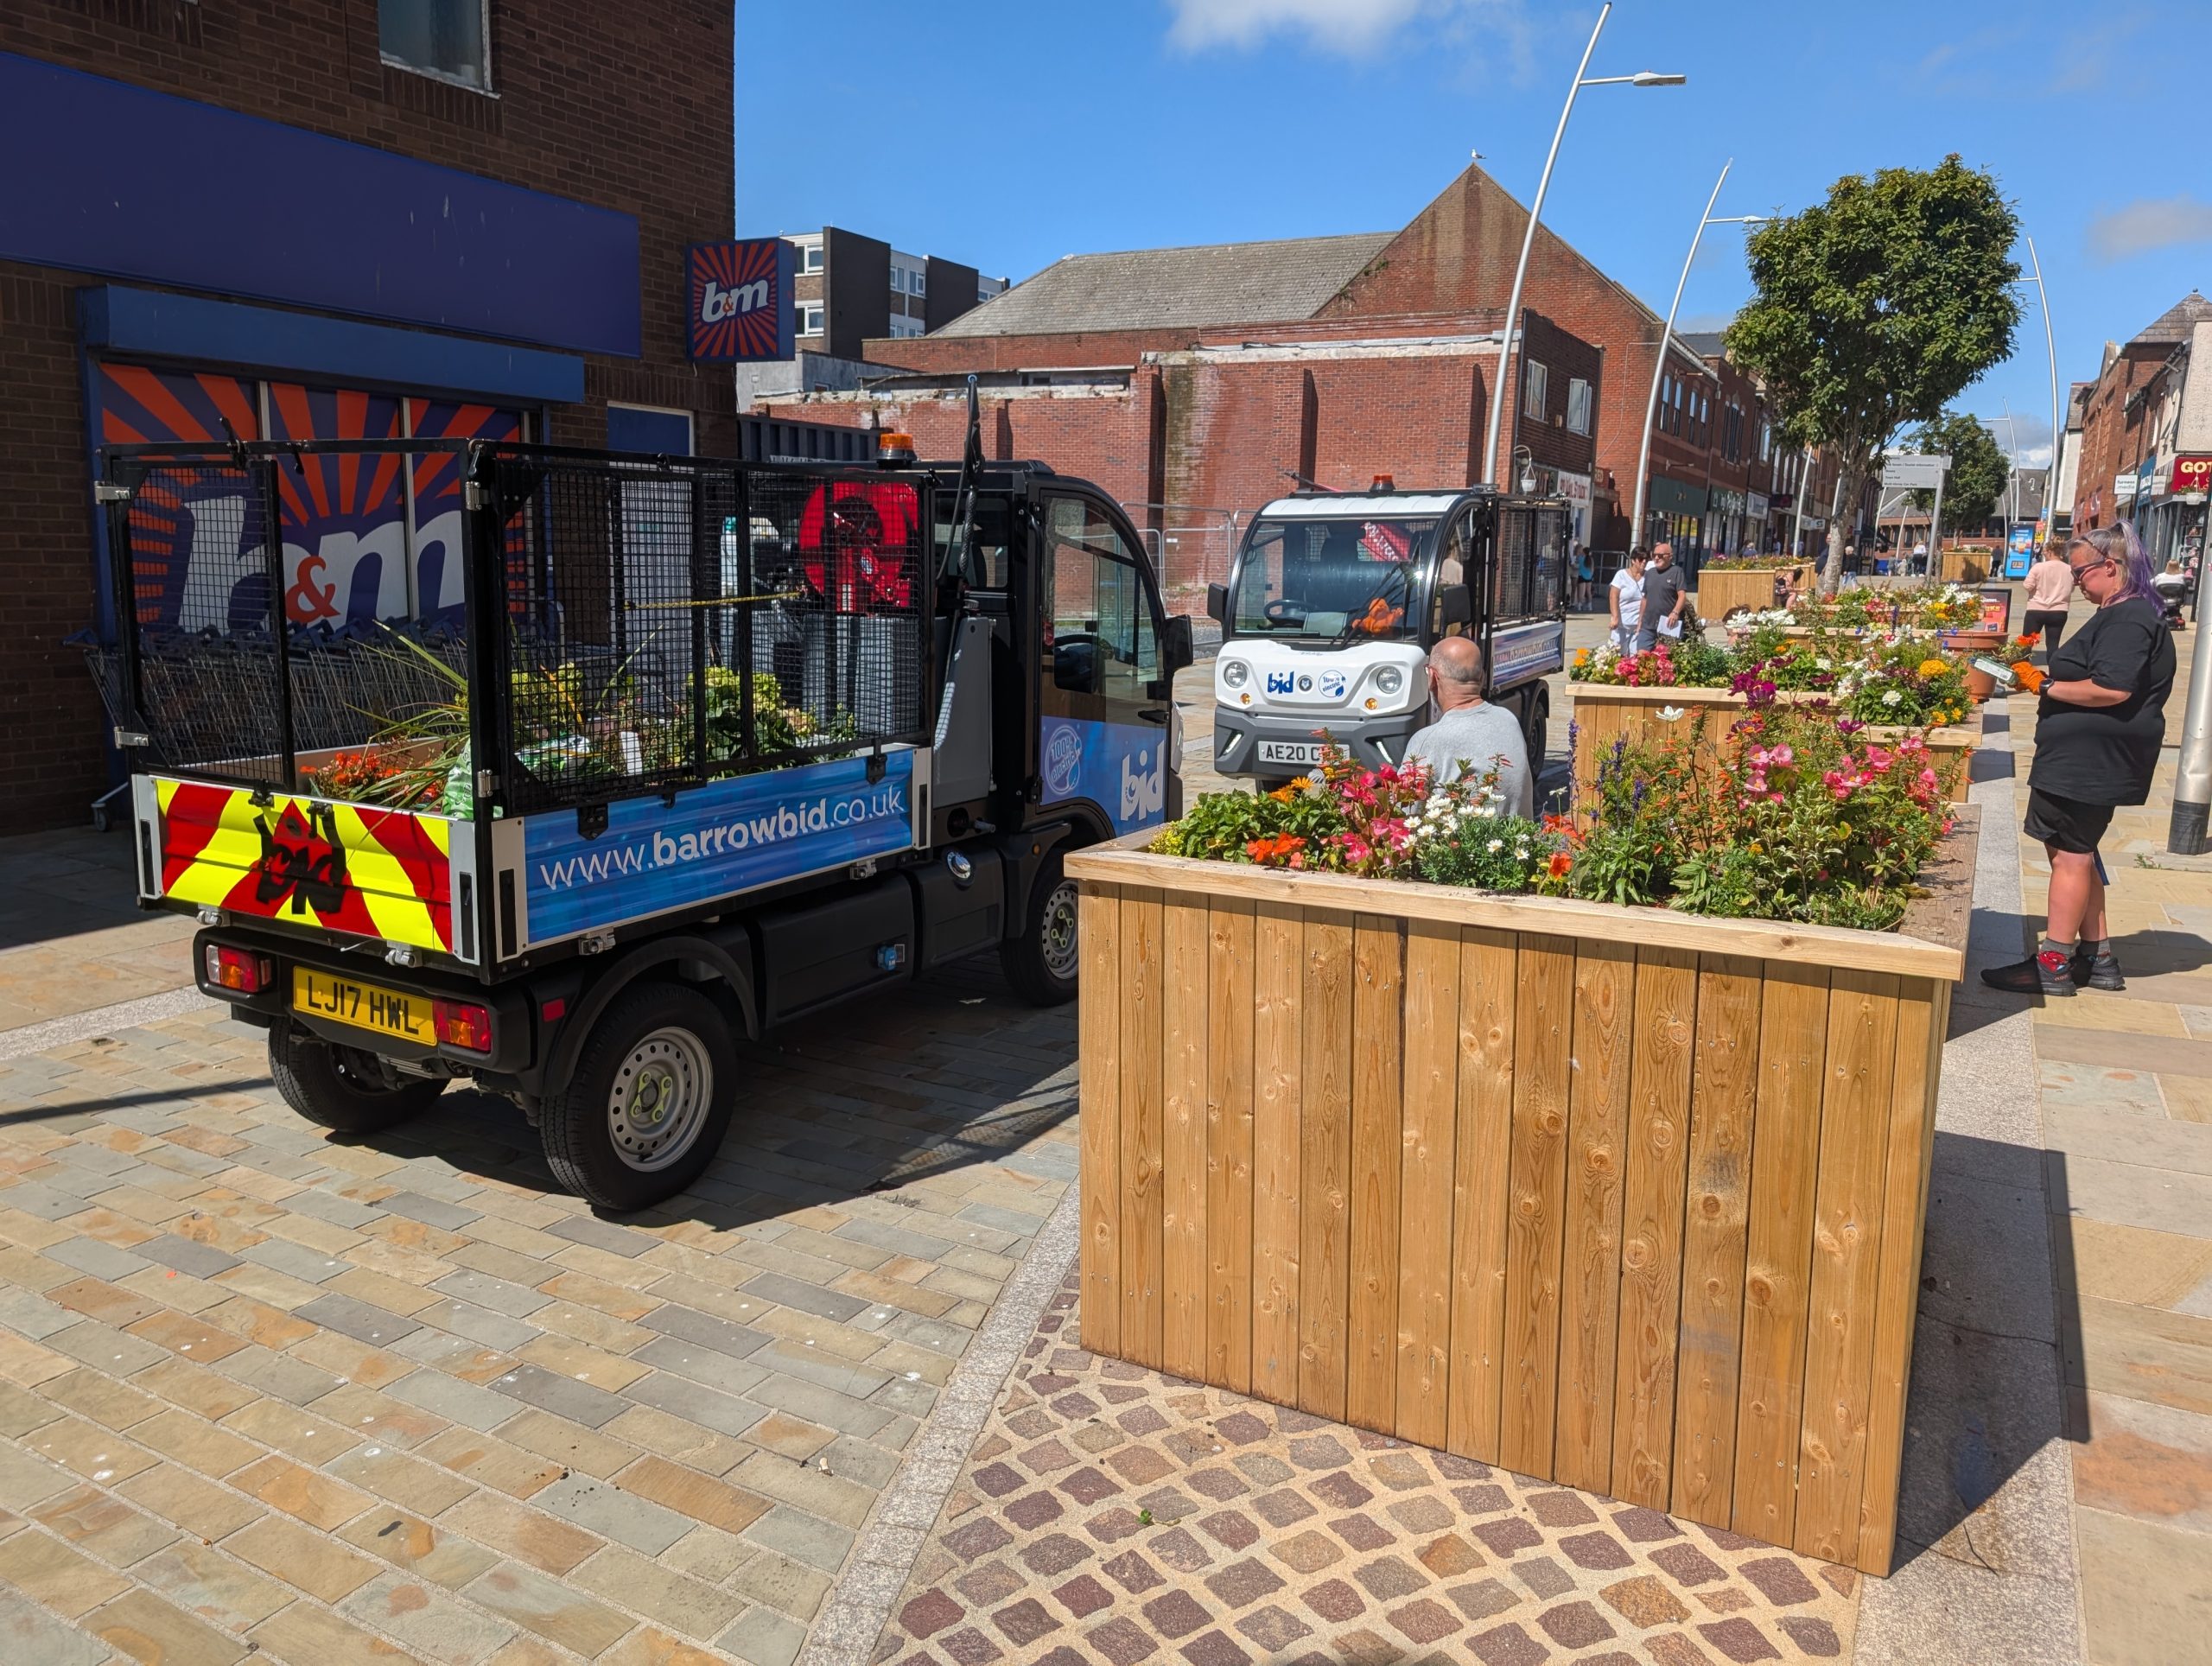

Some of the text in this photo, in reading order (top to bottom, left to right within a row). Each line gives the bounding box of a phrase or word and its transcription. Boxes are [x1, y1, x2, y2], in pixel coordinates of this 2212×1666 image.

[702, 279, 769, 323] b&m
[1267, 671, 1294, 694] bid
[1051, 736, 1075, 761] 100%
[1266, 744, 1306, 761] AE20
[1051, 754, 1076, 781] electric
[1121, 740, 1164, 821] bid
[539, 784, 906, 892] www.barrowbid.co.uk
[308, 975, 419, 1036] LJ17 HWL
